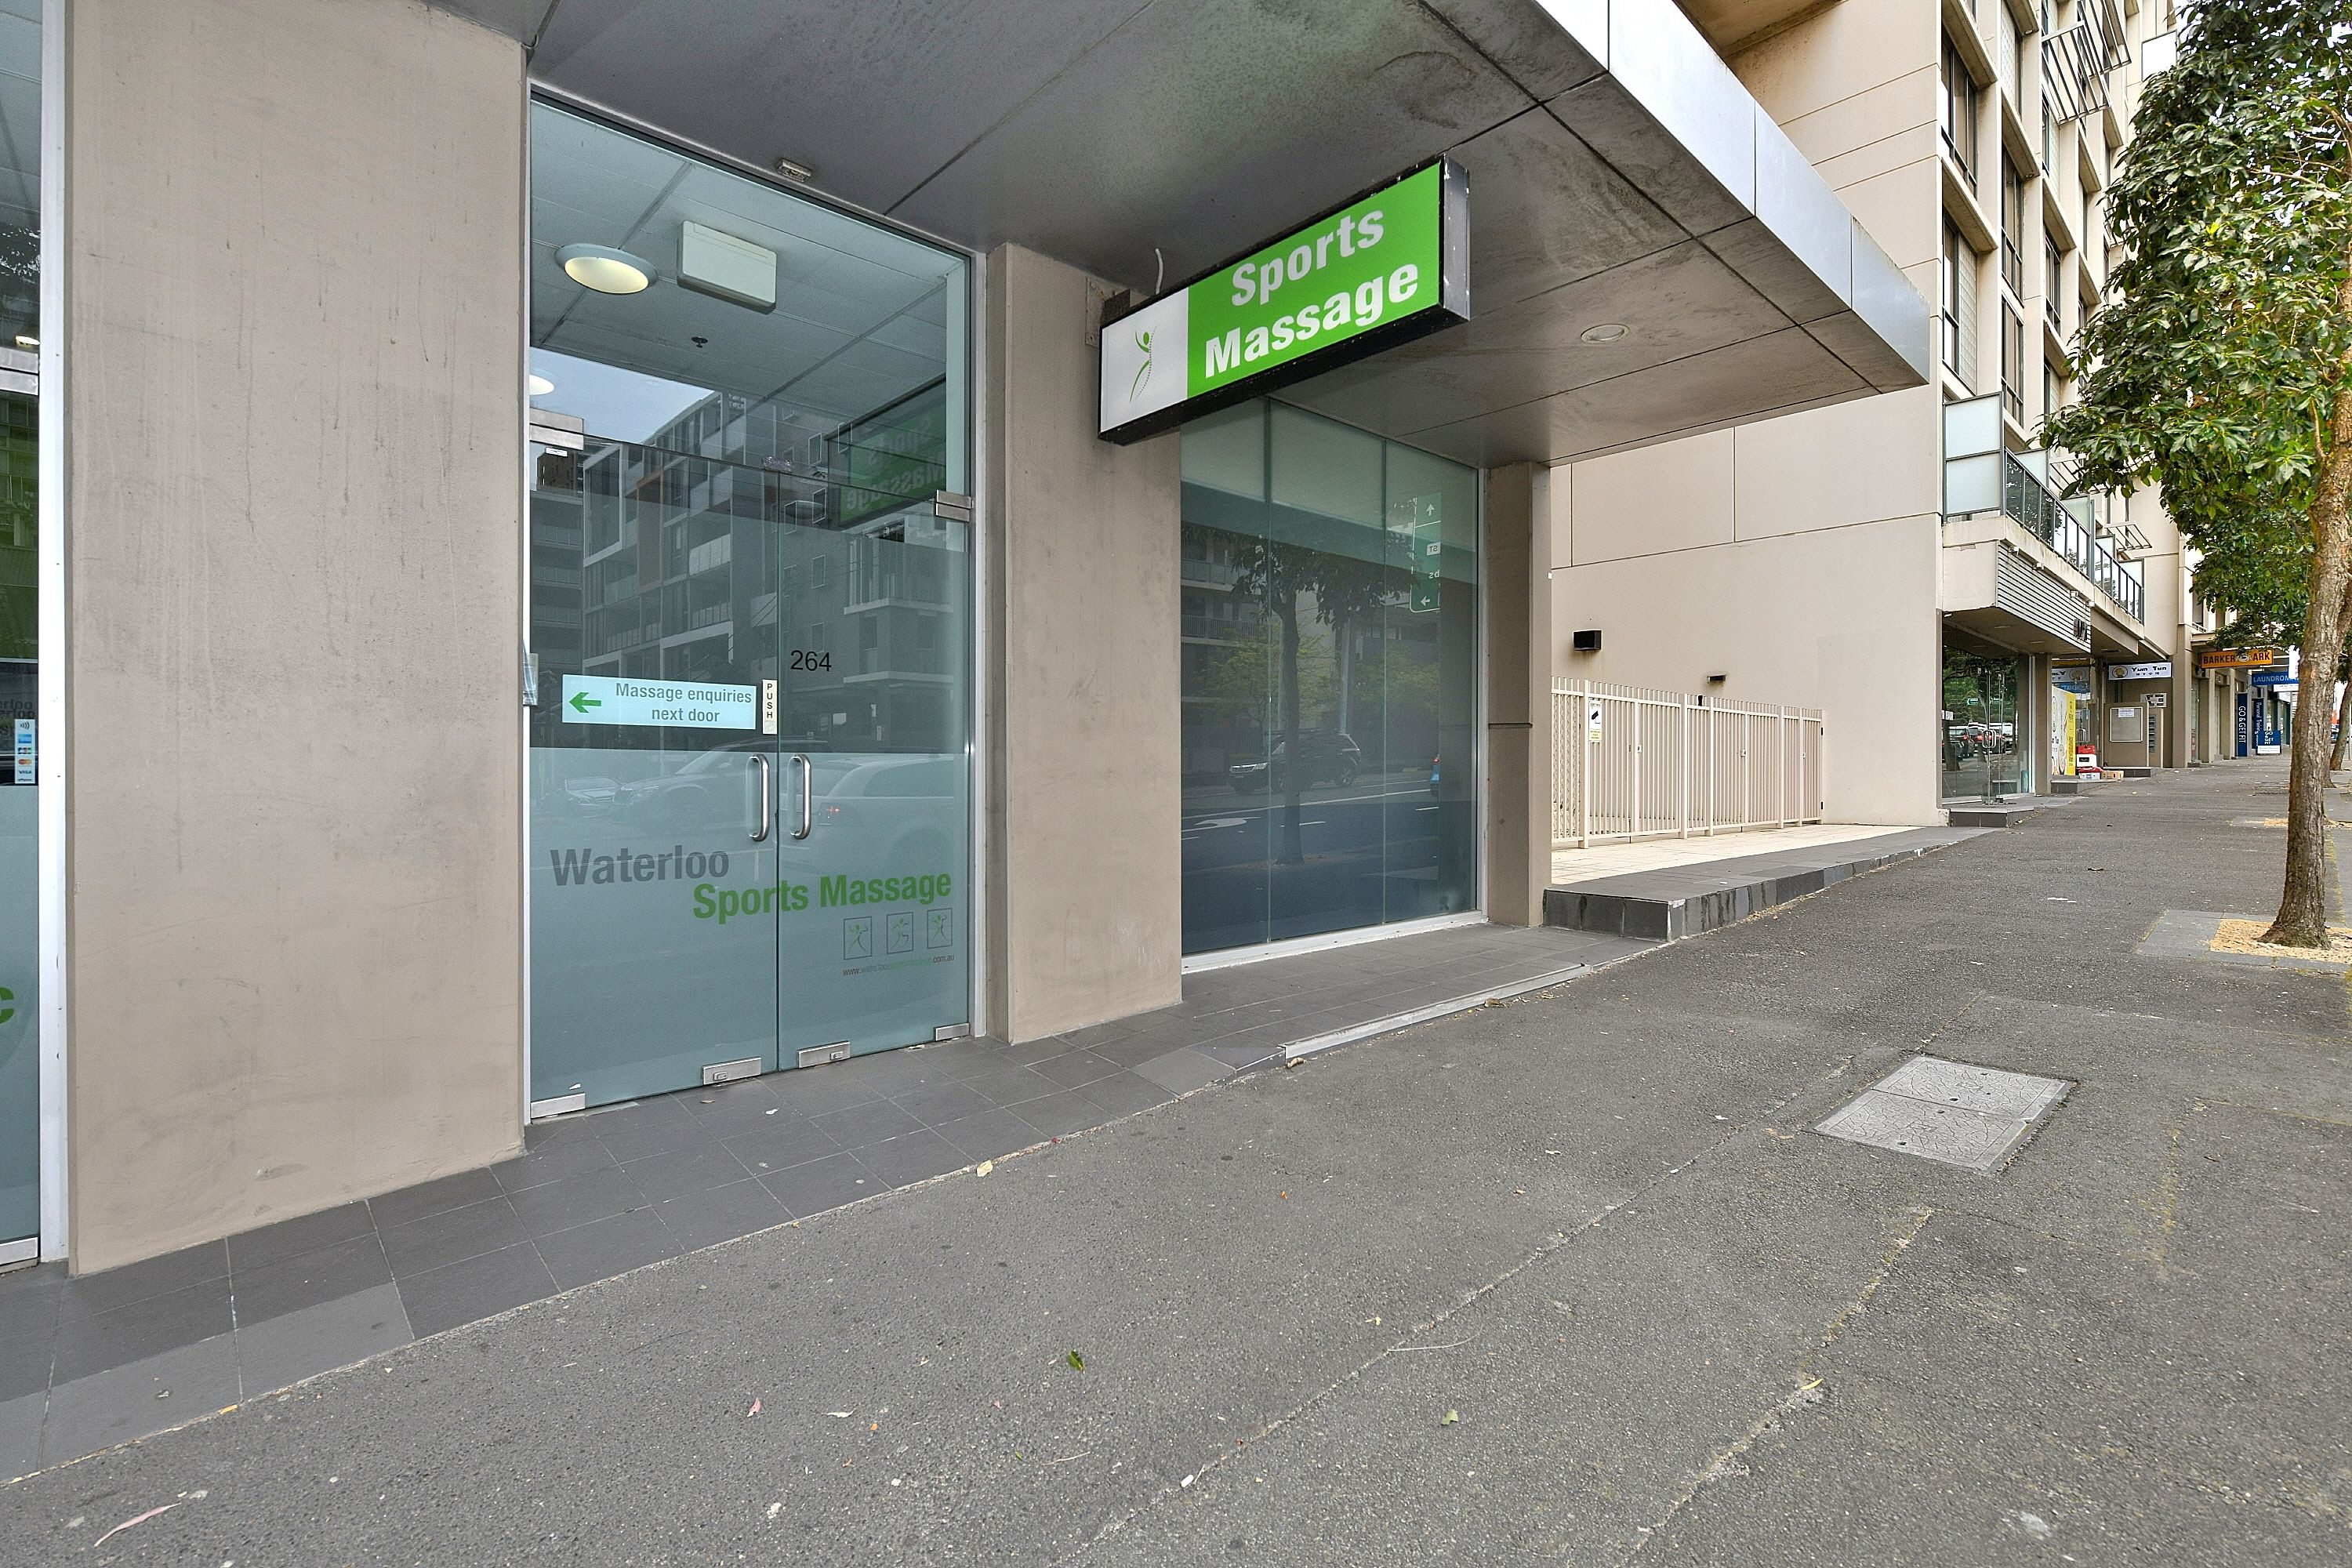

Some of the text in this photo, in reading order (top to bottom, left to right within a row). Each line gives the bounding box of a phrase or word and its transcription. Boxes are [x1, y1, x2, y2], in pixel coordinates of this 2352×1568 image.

[1232, 209, 1384, 306] Sports
[1205, 263, 1418, 379] Massage
[790, 650, 832, 672] 264
[2203, 652, 2270, 665] BARKER ARK
[615, 682, 752, 704] Massage enquiries
[652, 708, 720, 722] next door
[2238, 706, 2246, 717] GO
[550, 845, 729, 886] Waterloo
[693, 872, 952, 924] Sports Massage
